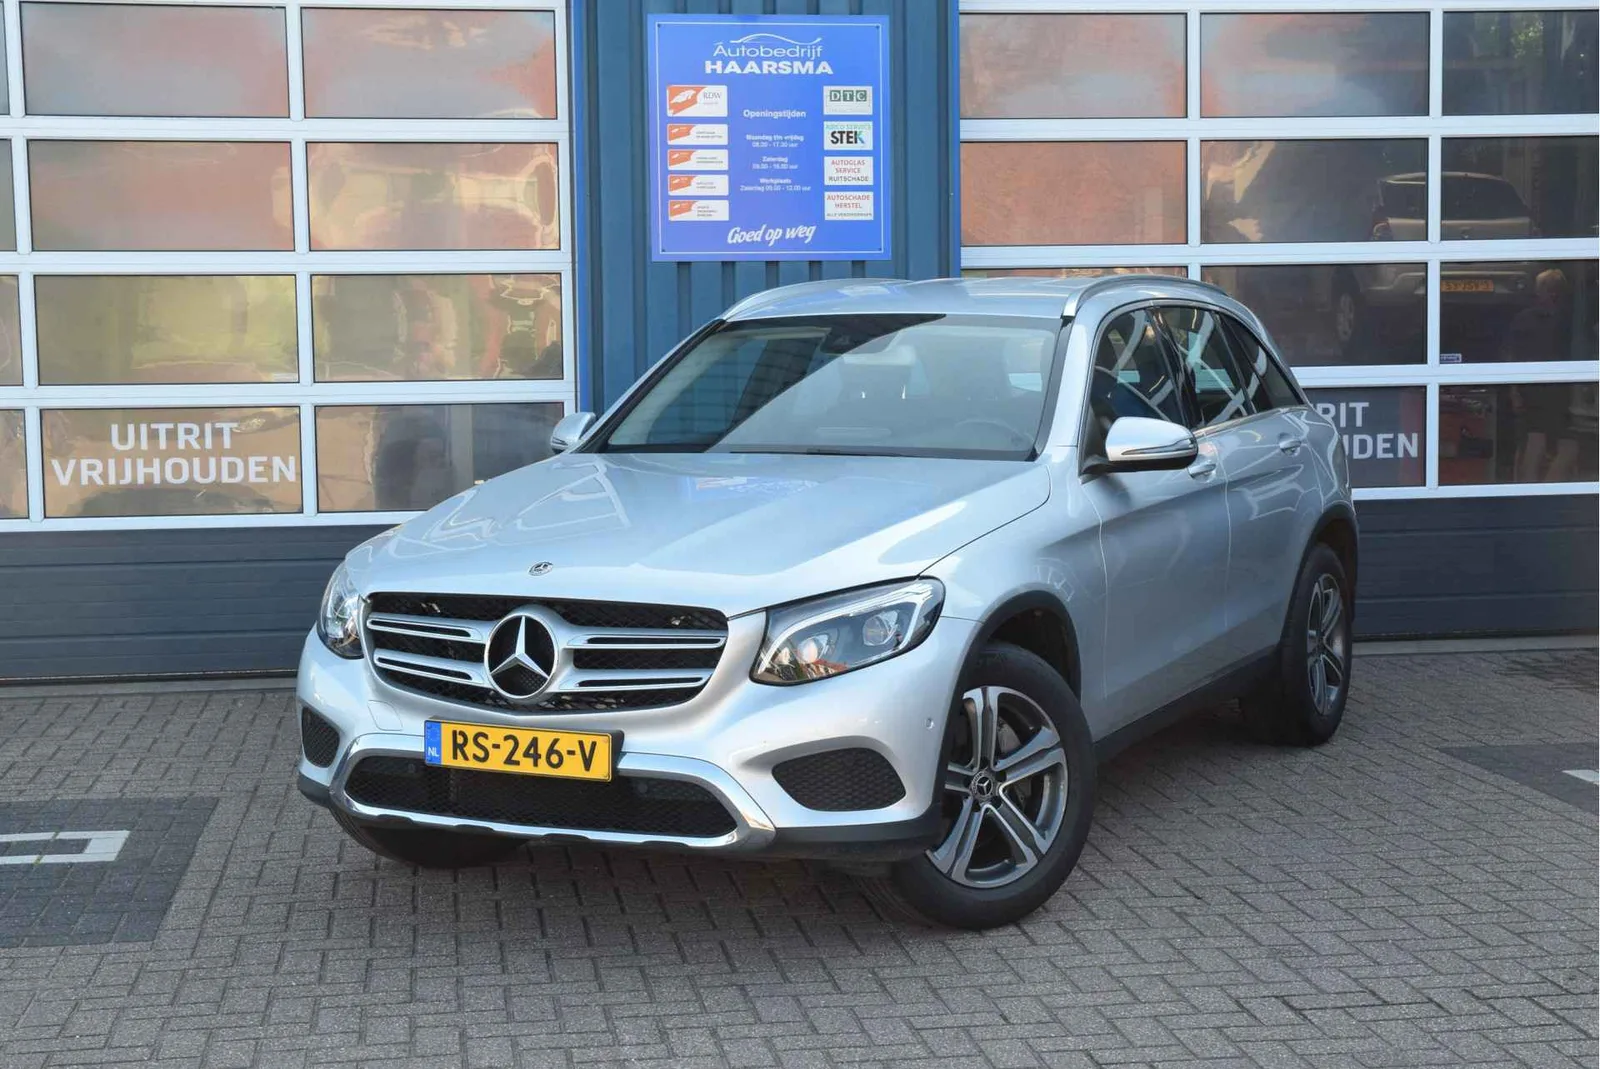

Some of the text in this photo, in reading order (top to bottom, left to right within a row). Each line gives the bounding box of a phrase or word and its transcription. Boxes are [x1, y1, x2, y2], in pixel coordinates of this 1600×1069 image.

[713, 45, 822, 60] Autobedrijf
[705, 61, 833, 74] HAARSMA
[830, 90, 867, 101] DTC
[743, 109, 806, 119] Openingstijden
[831, 130, 865, 144] STEK
[727, 224, 817, 247] Goed op weg
[1311, 402, 1370, 428] RIT
[111, 422, 239, 451] UITRIT
[1342, 432, 1418, 459] DEN
[51, 456, 296, 486] VRIJHOUDEN
[427, 746, 440, 757] NL
[452, 729, 597, 772] RS-246-V
